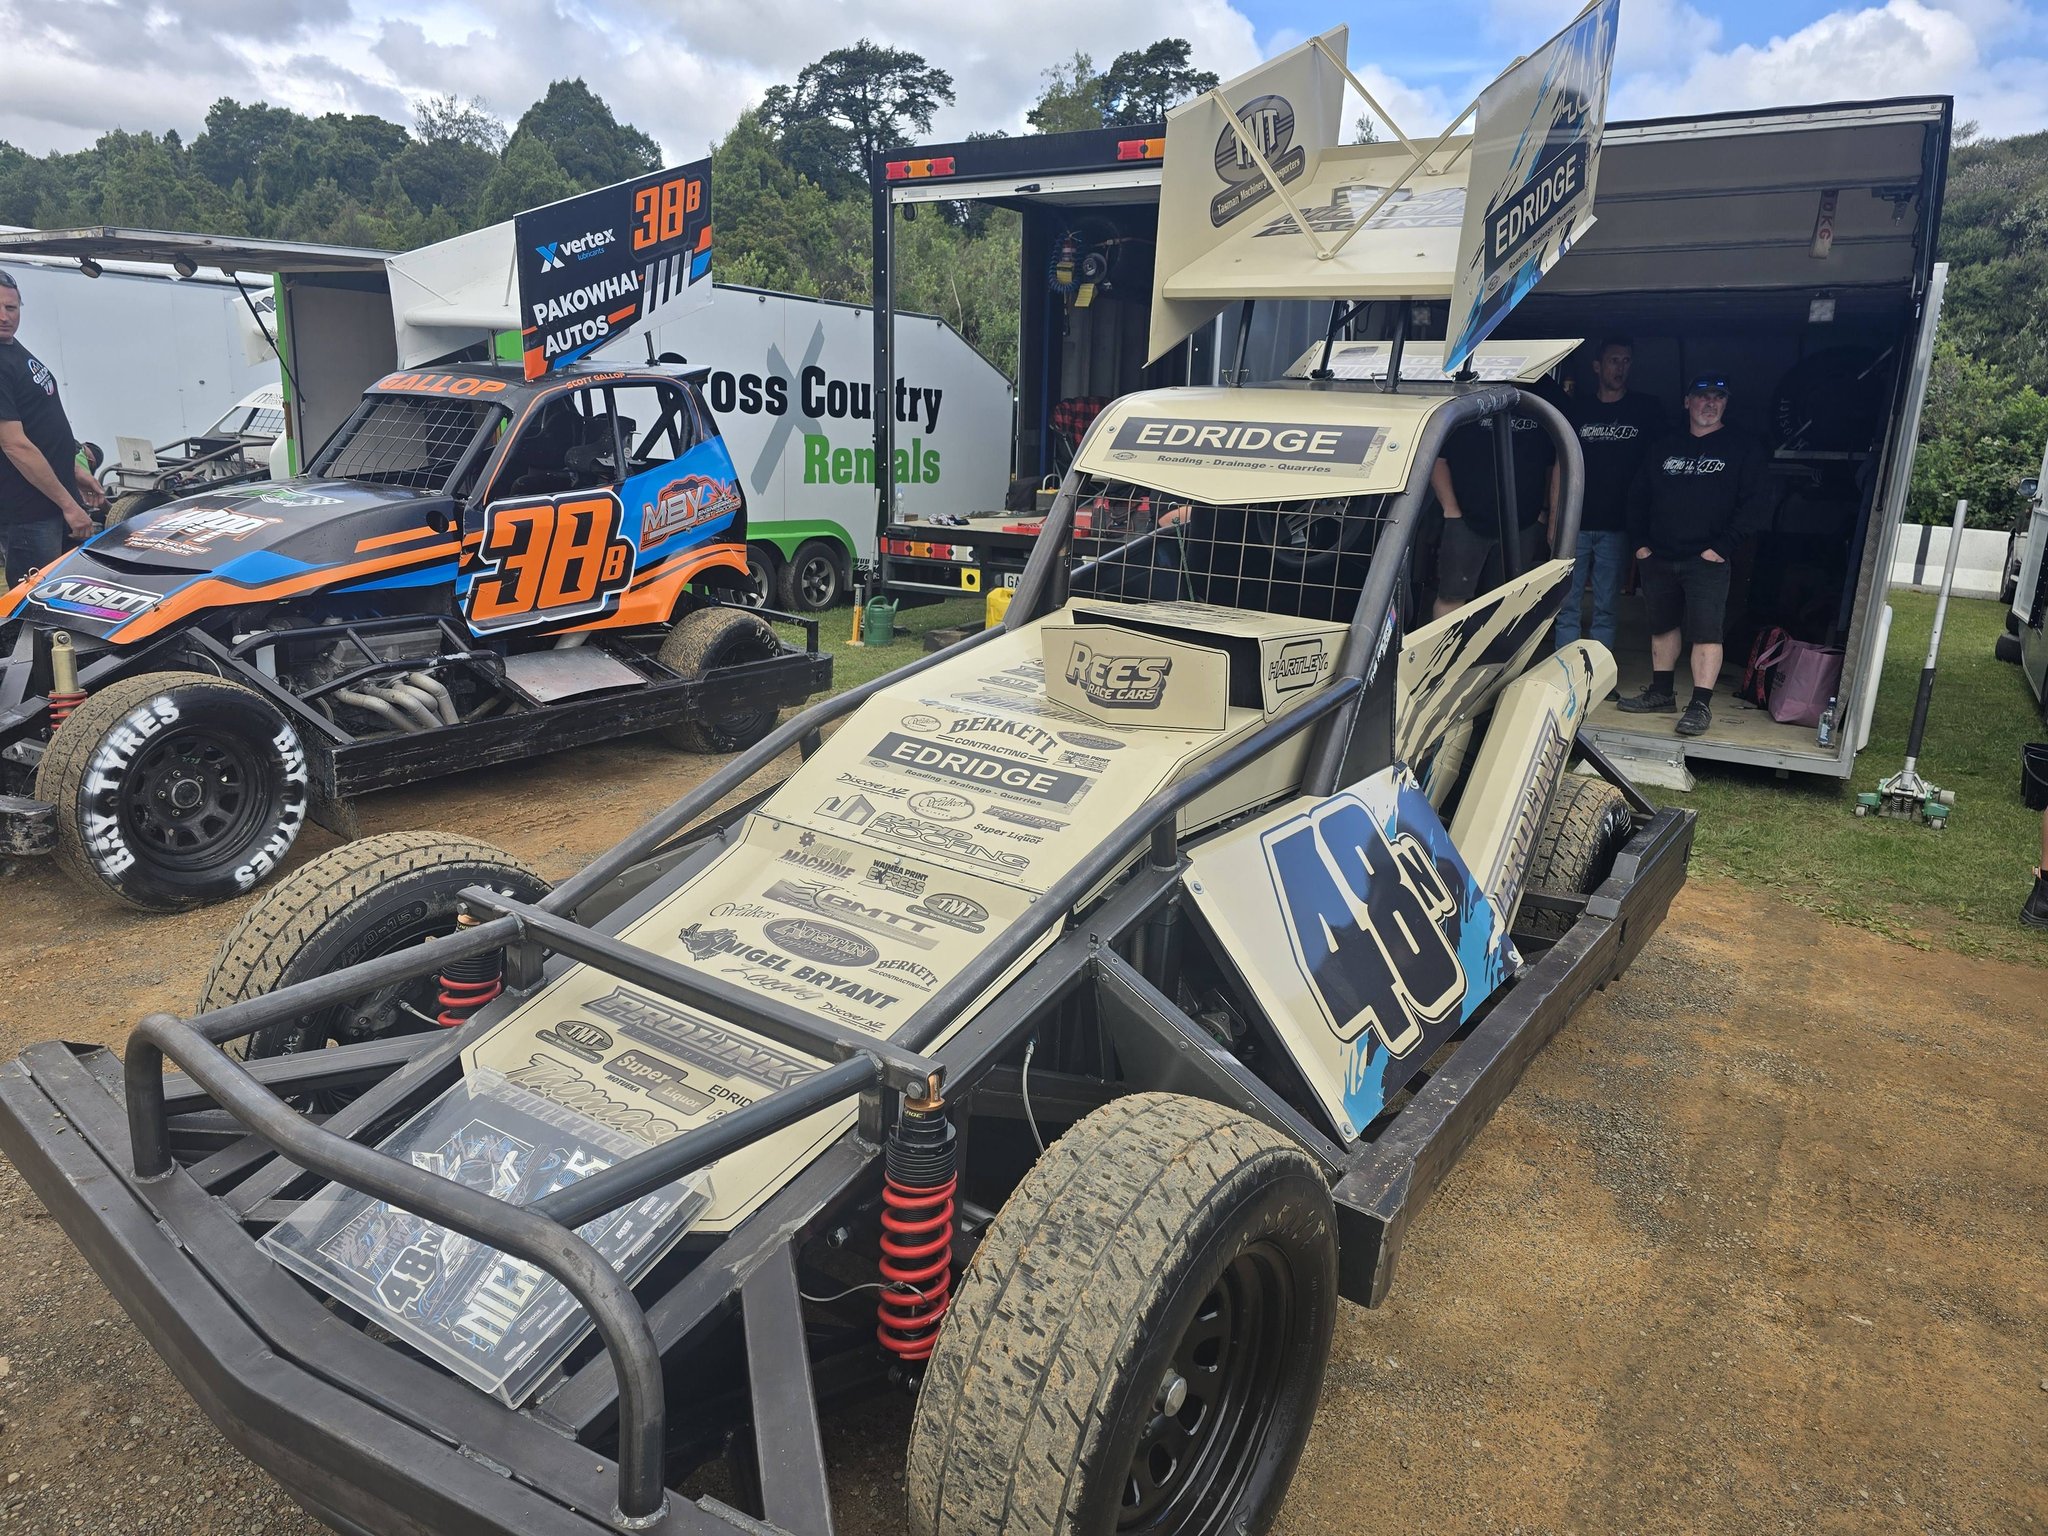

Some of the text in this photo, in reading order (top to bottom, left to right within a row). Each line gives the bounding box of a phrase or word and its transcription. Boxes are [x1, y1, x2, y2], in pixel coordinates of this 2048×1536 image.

[1217, 195, 1240, 215] Tasman
[1240, 178, 1268, 200] Machinery
[1495, 154, 1577, 259] EDRIDGE
[634, 178, 701, 250] 38B
[560, 228, 616, 257] vertex
[1508, 203, 1576, 272] Roading Drainage Quarries
[577, 247, 605, 261] lubricants
[533, 270, 639, 326] PAKOWHAI
[545, 315, 609, 358] AUTOS
[377, 374, 506, 396] GALLOP
[566, 372, 625, 390] SCOTT GALLOP
[801, 365, 943, 434] Coutry
[1135, 423, 1343, 455] EDRIDGE
[803, 434, 941, 485] Renals
[1156, 454, 1331, 473] Roading Drainage Quarries
[471, 498, 627, 622] 38B
[1066, 641, 1172, 688] REES
[1088, 684, 1156, 700] RACE CARS
[85, 696, 180, 794] TYRES
[947, 716, 1059, 755] BERKETT
[954, 737, 1029, 760] CONTRACTING
[272, 722, 308, 784] BAY
[891, 741, 1059, 794] EDRIDGE
[1090, 755, 1111, 763] PRINT
[836, 772, 888, 790] Discover
[890, 786, 911, 796] NZ
[904, 768, 1042, 807] Roading Drainage Quarries
[874, 811, 973, 841] RAPID
[974, 824, 1043, 845] Super Liquor
[85, 814, 136, 876] BAY
[234, 799, 308, 888] TYRES
[868, 821, 1030, 870] ROOFING
[781, 849, 856, 879] MACHINE
[873, 860, 928, 882] WAIMEA PRINT
[866, 867, 926, 895] EXPRESS
[937, 898, 979, 919] TMT
[773, 920, 872, 958] AUSTIN
[1268, 798, 1466, 1052] 48N
[715, 934, 786, 973] NIGEL
[791, 965, 901, 1010] BRYANT
[877, 959, 939, 988] BERKETT
[878, 970, 920, 990] CONTRACTING
[816, 1001, 867, 1022] Discover
[867, 1019, 887, 1029] NZ
[566, 1024, 604, 1047] TMT
[624, 1026, 735, 1078] PERFORMANCE
[605, 1074, 641, 1093] MOTUEKA
[617, 1056, 671, 1085] Super
[661, 1086, 699, 1108] Liquor
